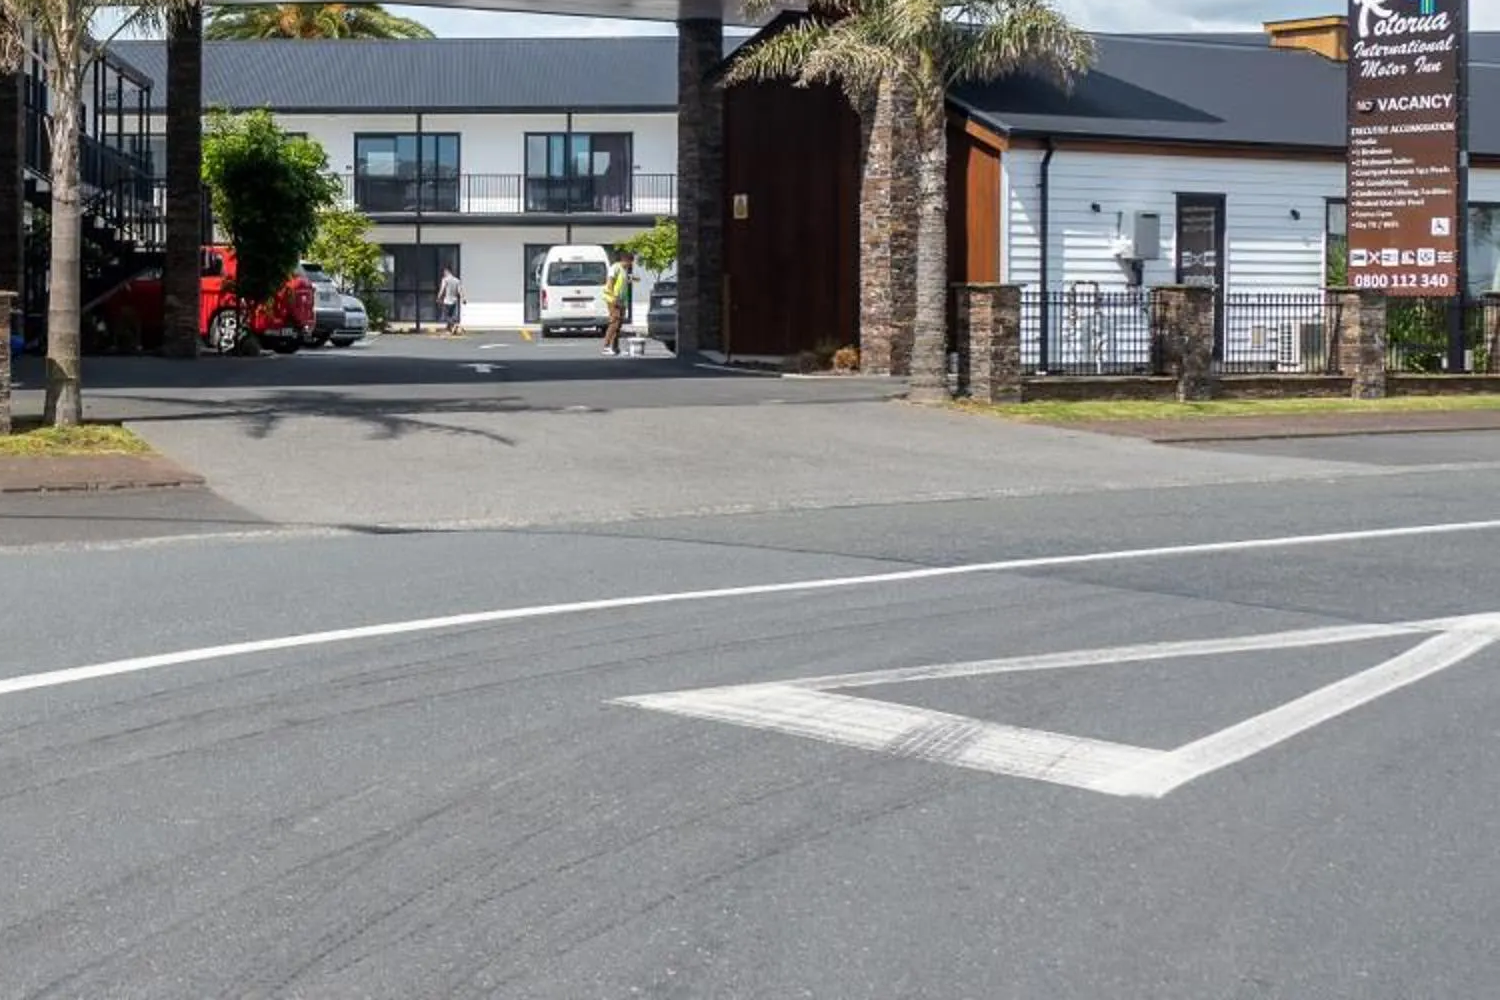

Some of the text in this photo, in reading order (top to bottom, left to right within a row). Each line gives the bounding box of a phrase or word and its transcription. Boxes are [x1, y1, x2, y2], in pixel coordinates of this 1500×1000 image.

[1353, 34, 1455, 59] International
[1360, 55, 1442, 78] Motor Inn
[1377, 92, 1453, 111] VACANCY
[1354, 272, 1450, 289] 0800 112 340
